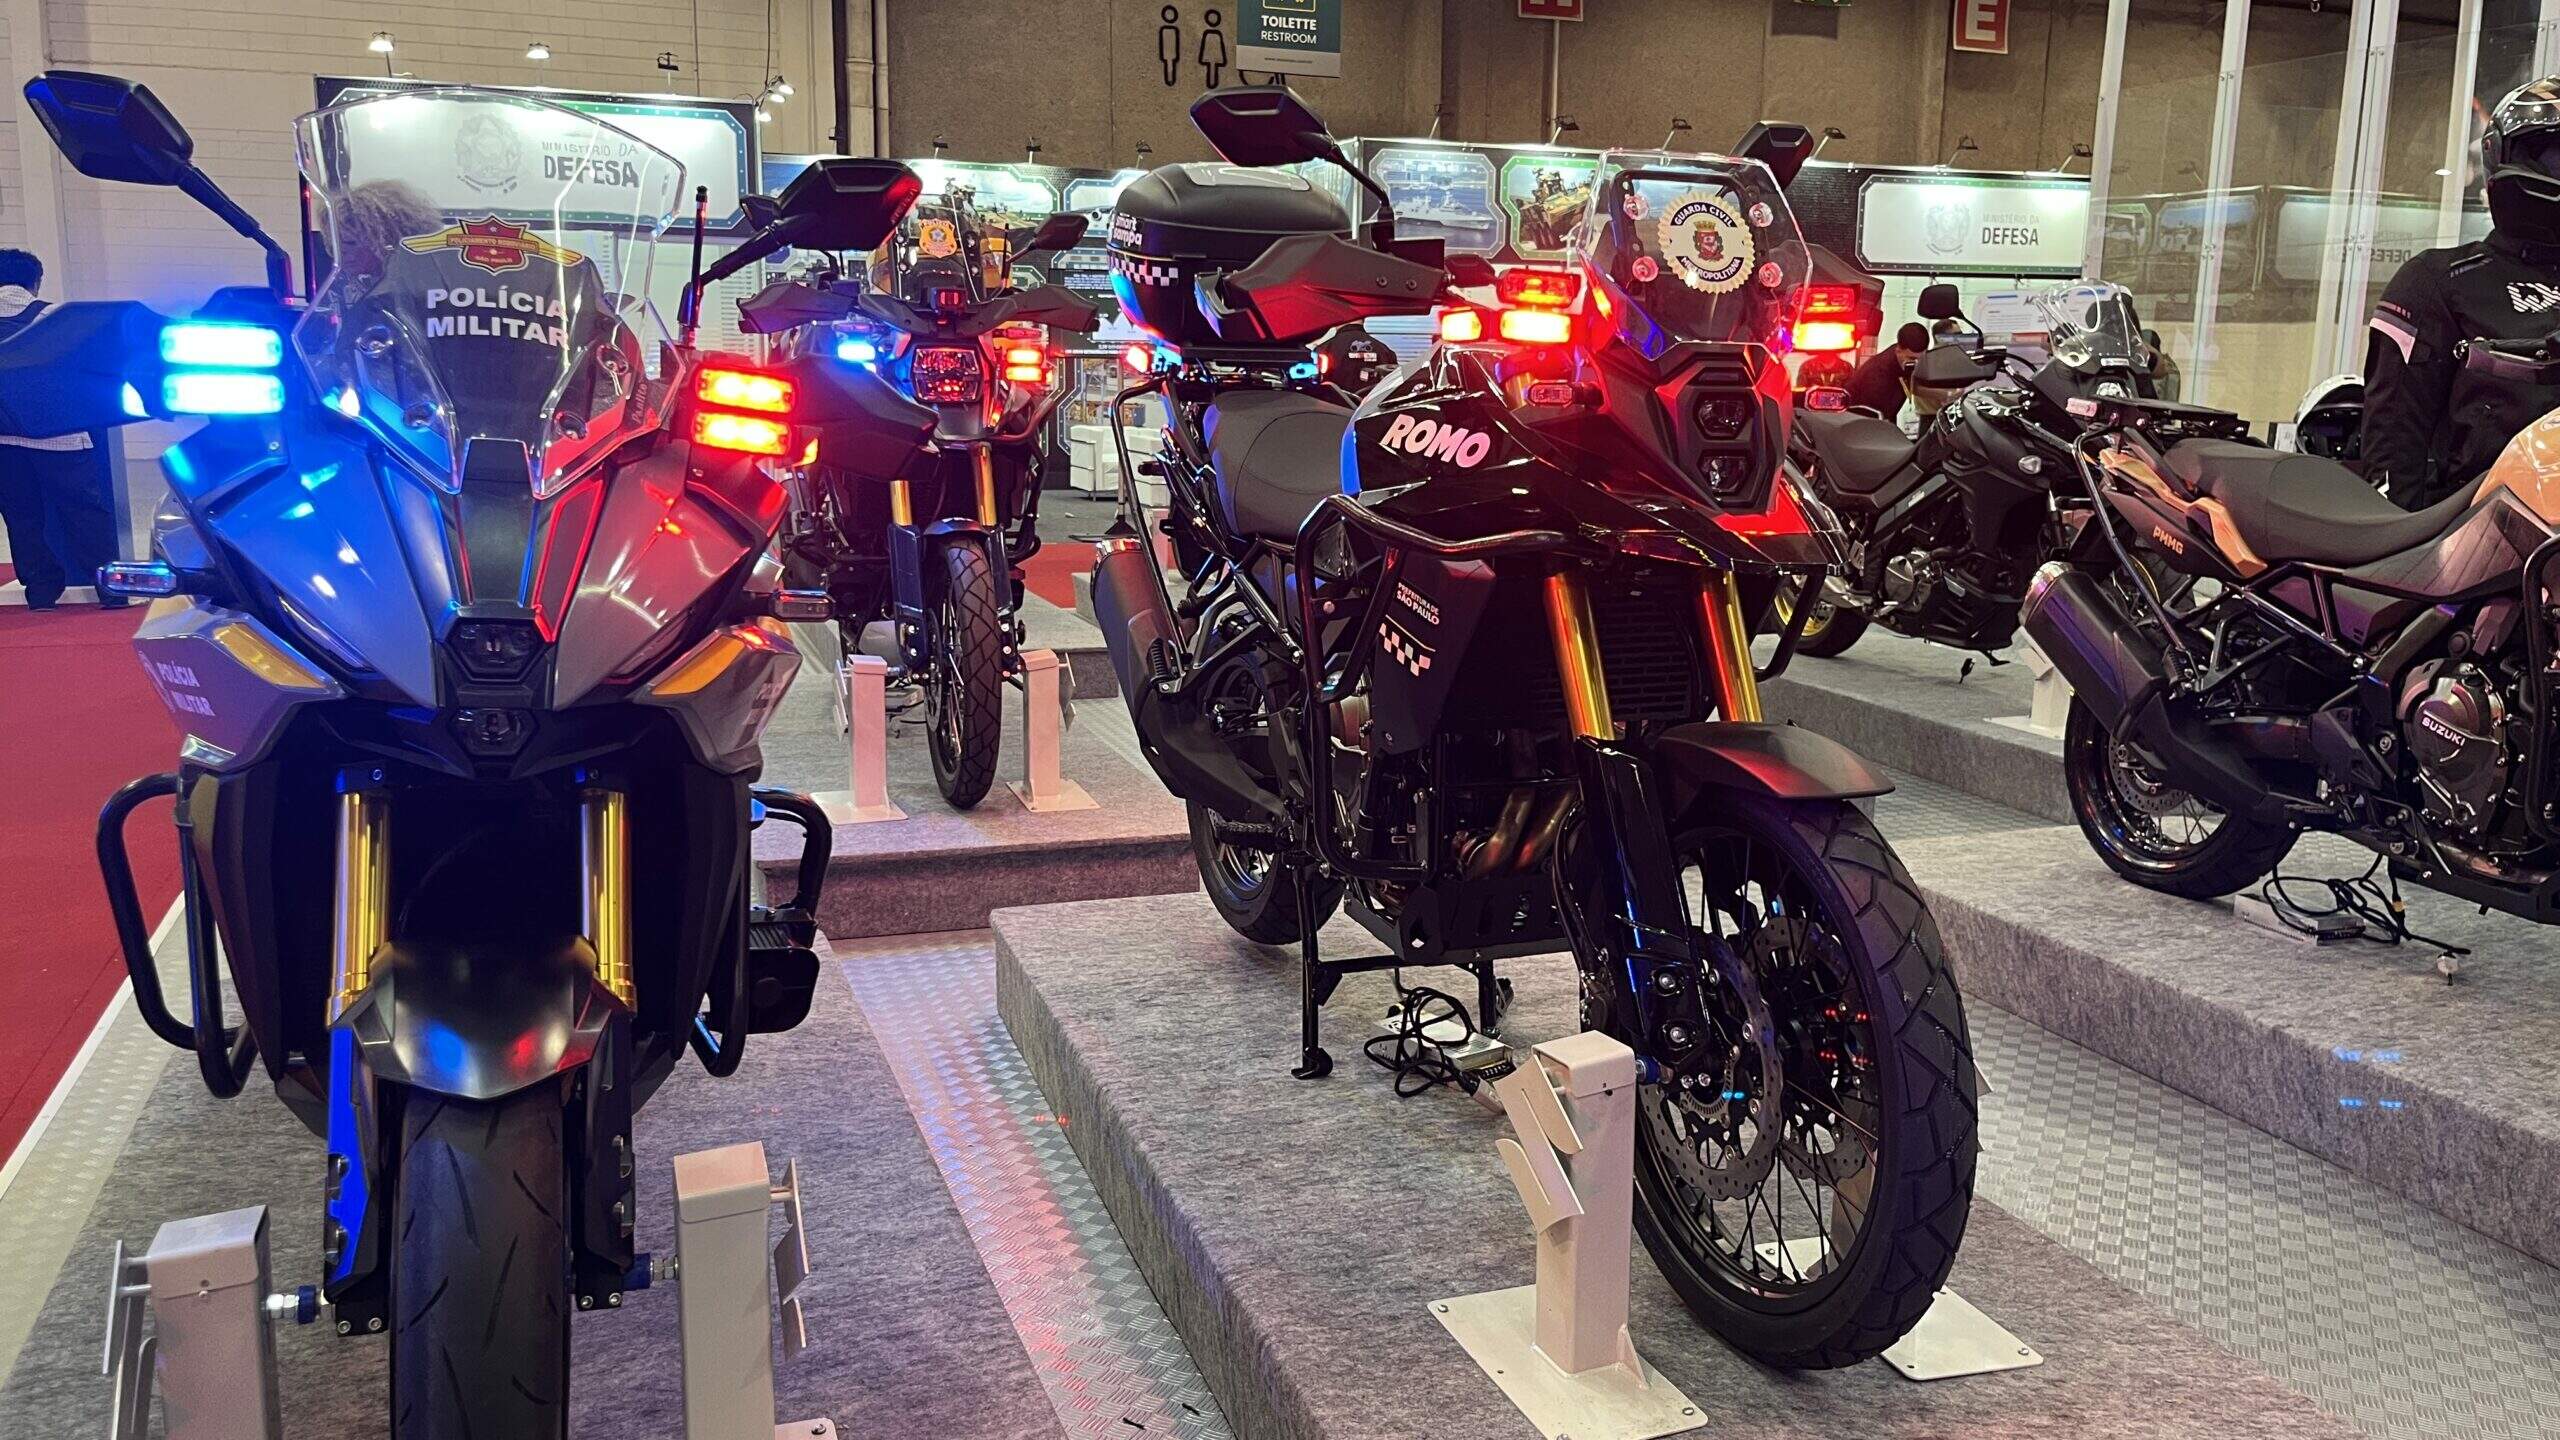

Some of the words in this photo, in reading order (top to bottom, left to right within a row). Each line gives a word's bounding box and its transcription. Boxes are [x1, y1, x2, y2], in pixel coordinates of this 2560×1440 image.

[1261, 15, 1317, 31] TOILETTE
[1261, 30, 1317, 44] RESTROOM
[619, 142, 639, 157] DA
[544, 155, 639, 188] DEFESA
[1674, 204, 1708, 225] GUARDA
[1709, 206, 1733, 227] CIVIL
[1982, 227, 2039, 246] DEFESA
[427, 285, 568, 320] POLÍCIA
[427, 316, 570, 350] MILITAR
[1379, 414, 1491, 468] ROMO
[2152, 525, 2184, 555] PMMG
[1396, 590, 1412, 607] SÃO
[1412, 603, 1440, 625] PAULO
[1398, 582, 1430, 609] PREFEITURA
[1430, 604, 1439, 615] DE
[156, 660, 200, 687] POLÍCIA
[170, 690, 216, 716] MILITAR
[2421, 717, 2466, 746] SUZUKI
